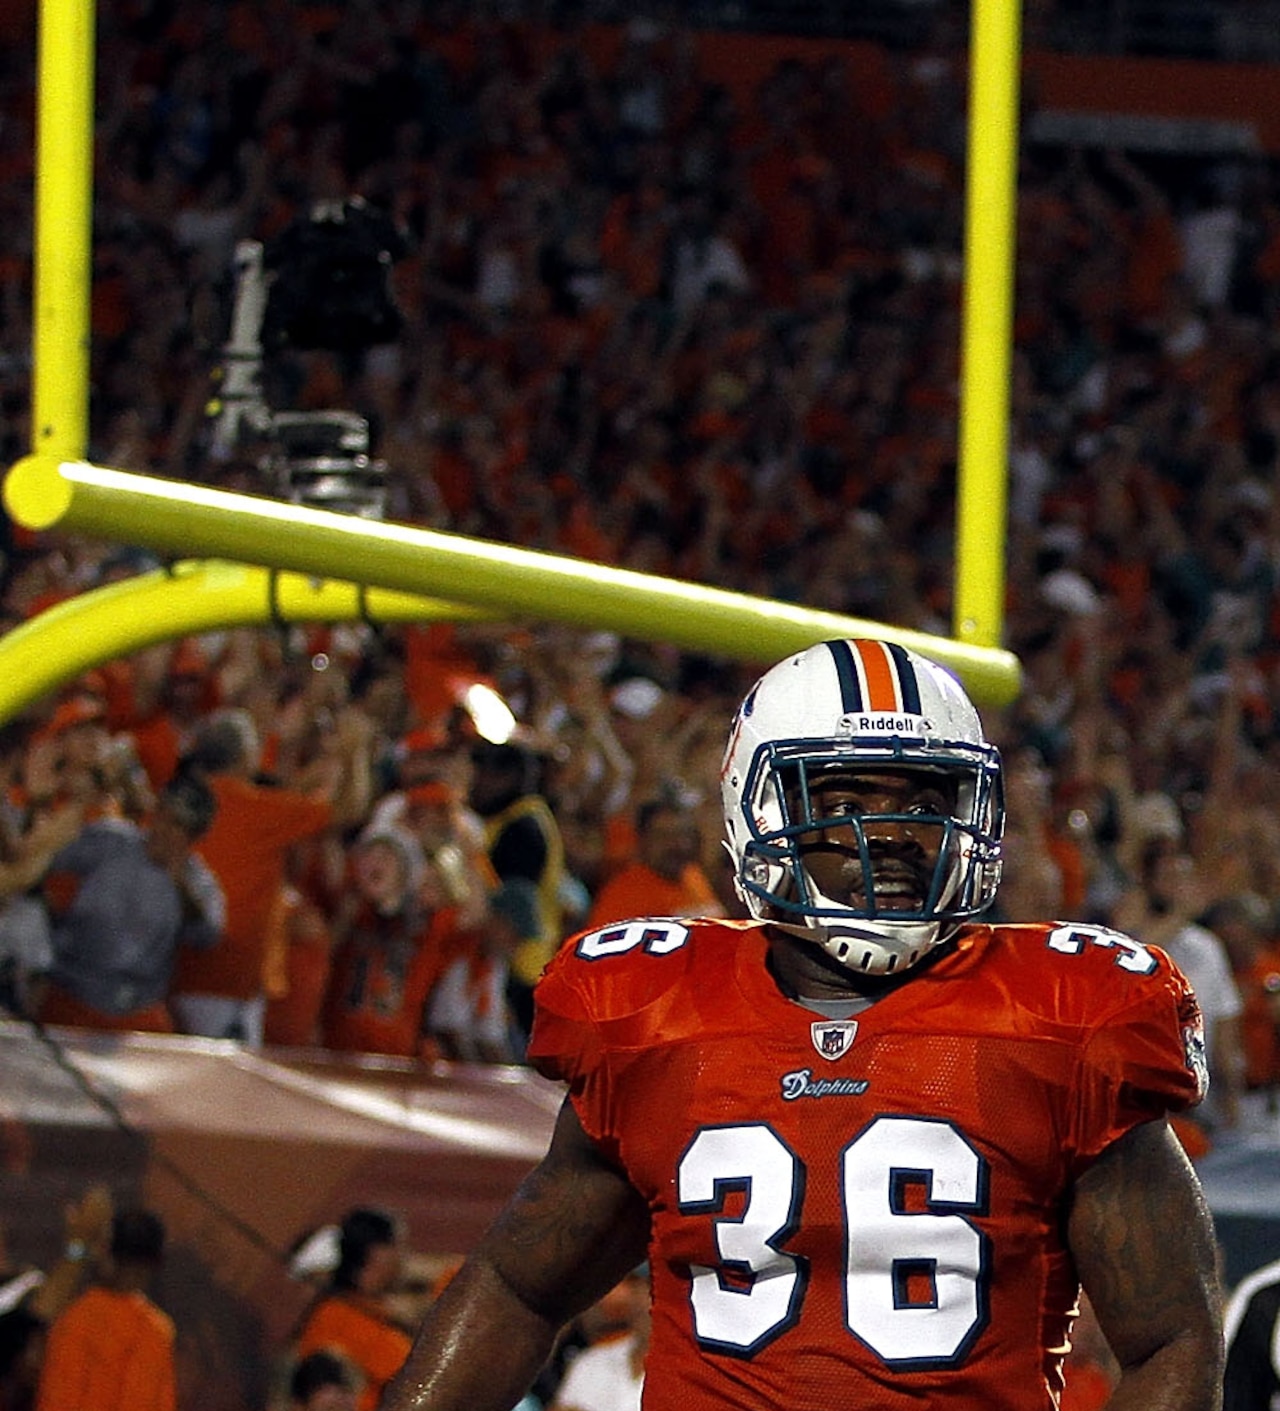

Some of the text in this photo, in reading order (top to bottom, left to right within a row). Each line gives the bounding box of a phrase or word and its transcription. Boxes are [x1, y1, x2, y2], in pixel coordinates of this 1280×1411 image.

[859, 717, 914, 732] Riddell
[780, 1067, 870, 1101] Dolphins
[677, 1113, 993, 1373] 36
